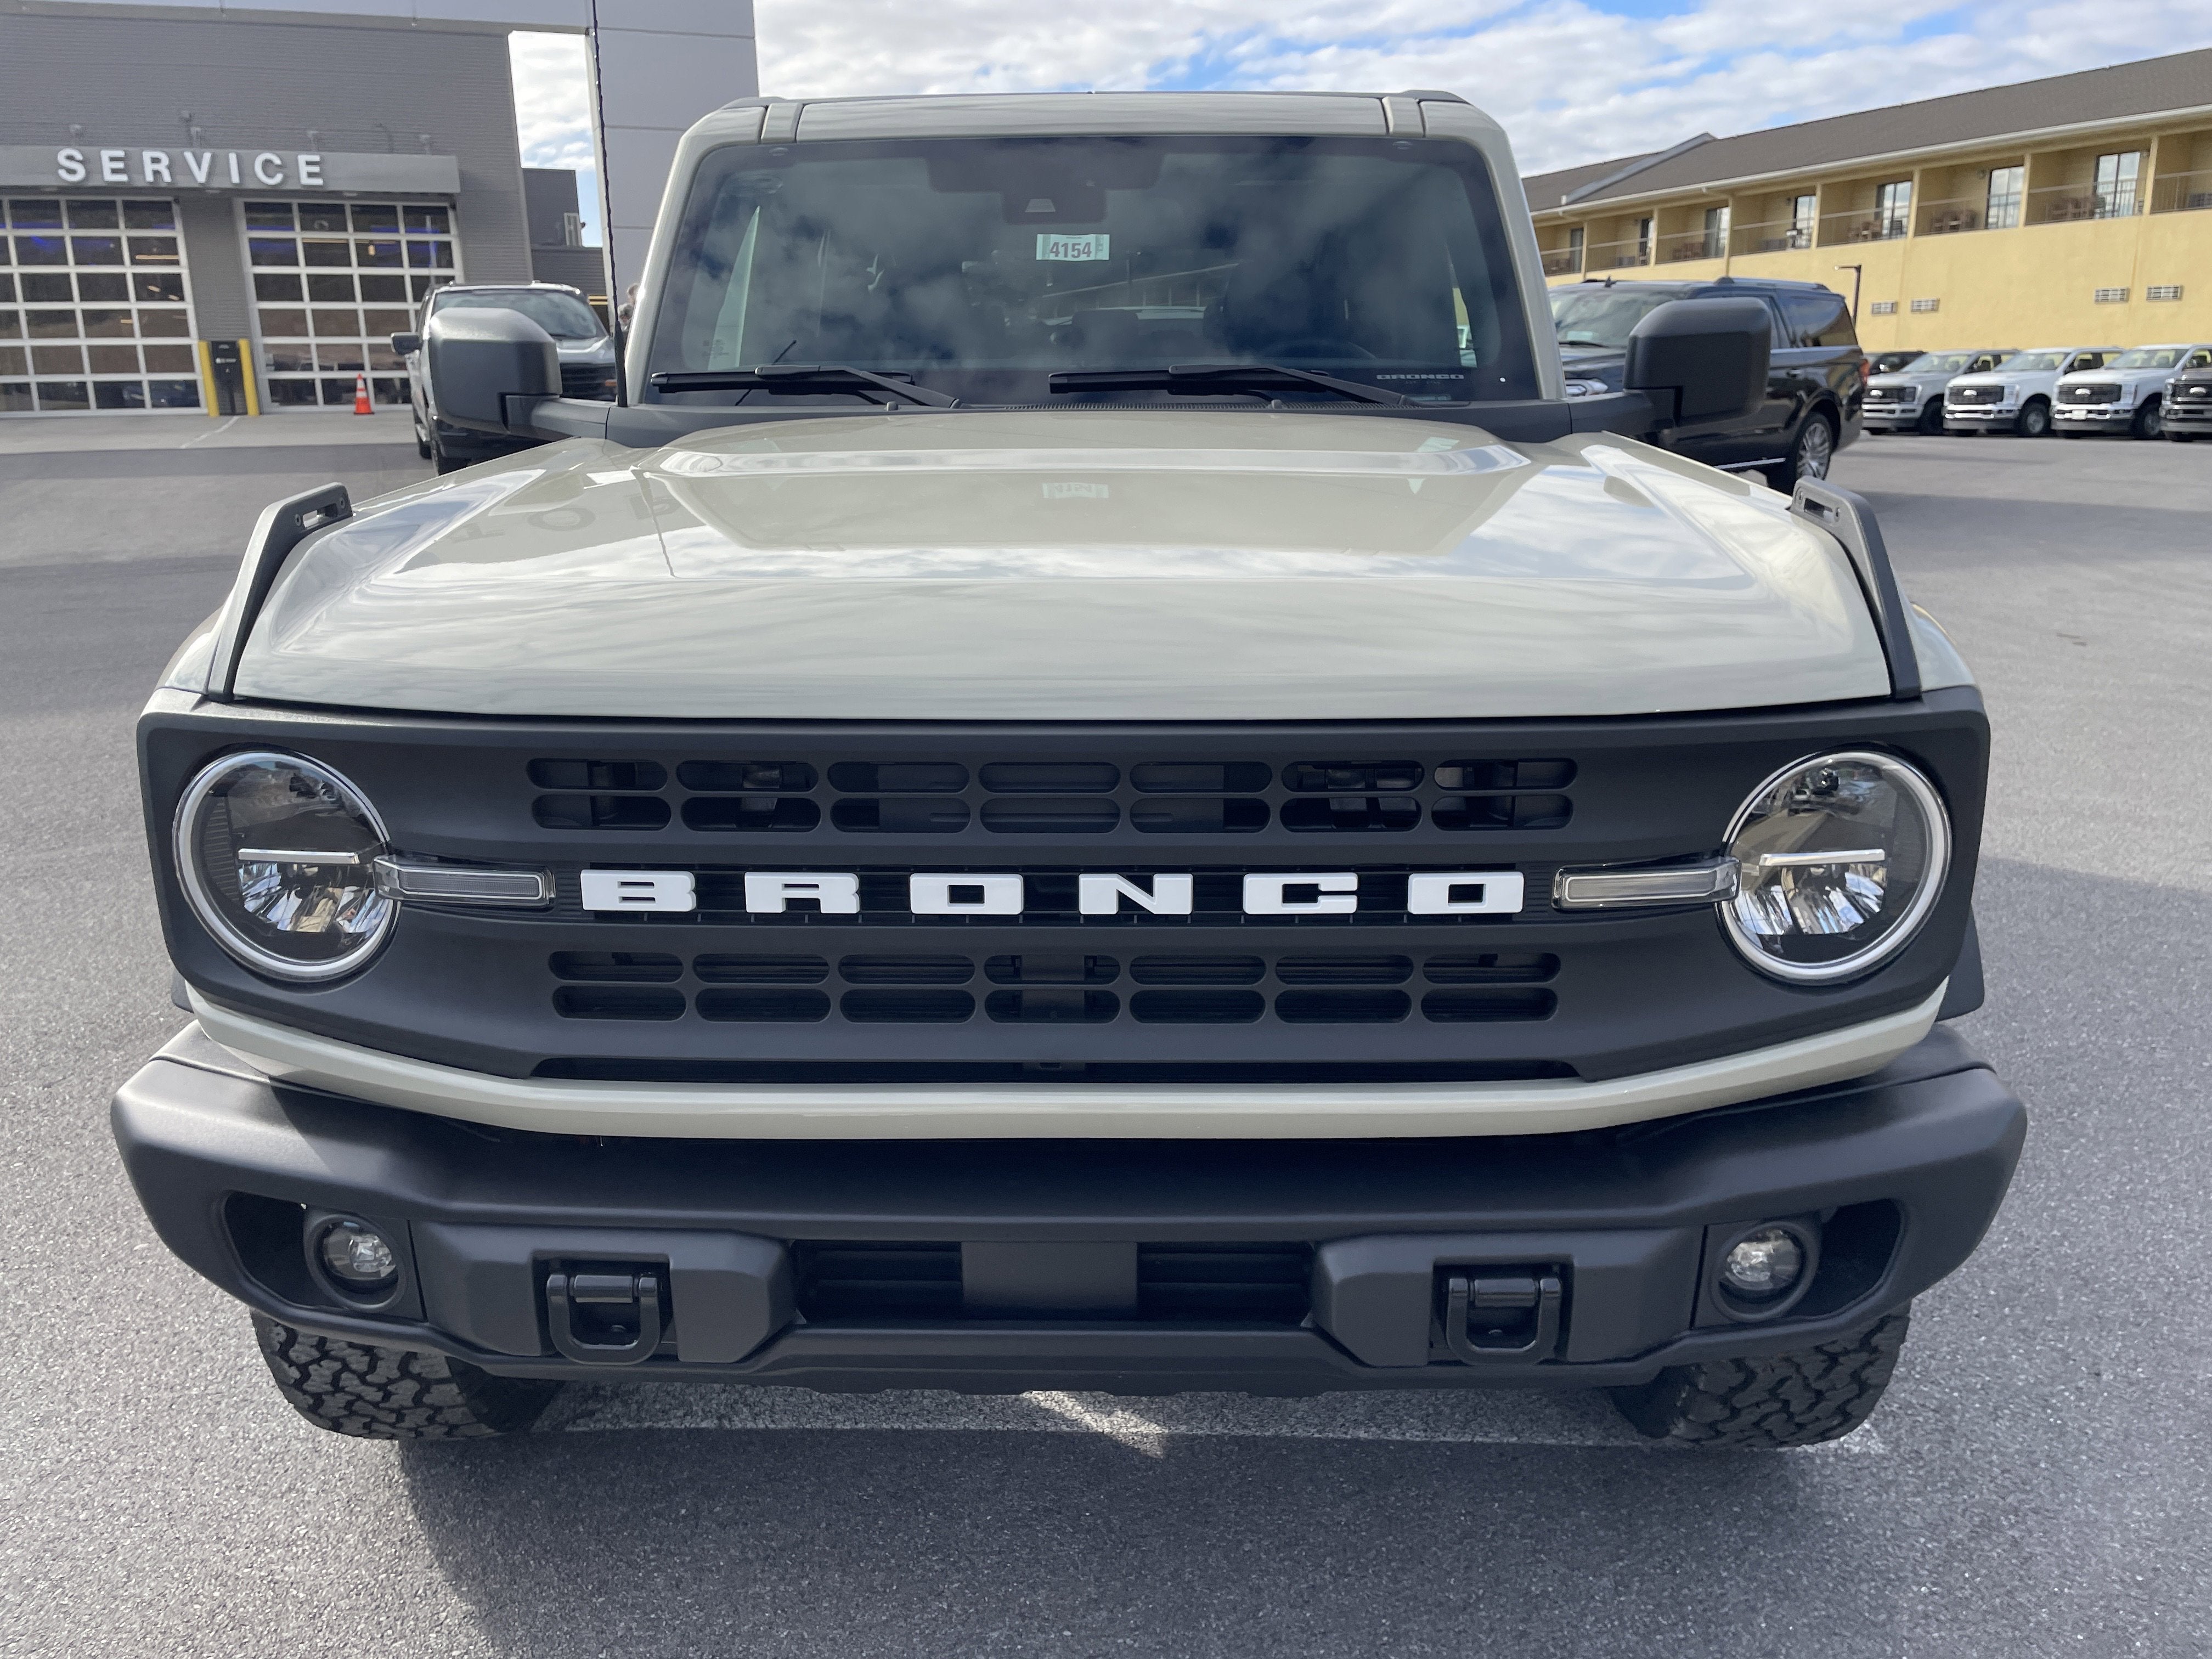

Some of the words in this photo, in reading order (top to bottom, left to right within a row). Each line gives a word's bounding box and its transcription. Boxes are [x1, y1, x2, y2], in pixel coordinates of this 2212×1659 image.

[57, 148, 324, 186] SERVICE
[1049, 242, 1092, 258] 4154
[580, 869, 1525, 915] BRONCO
